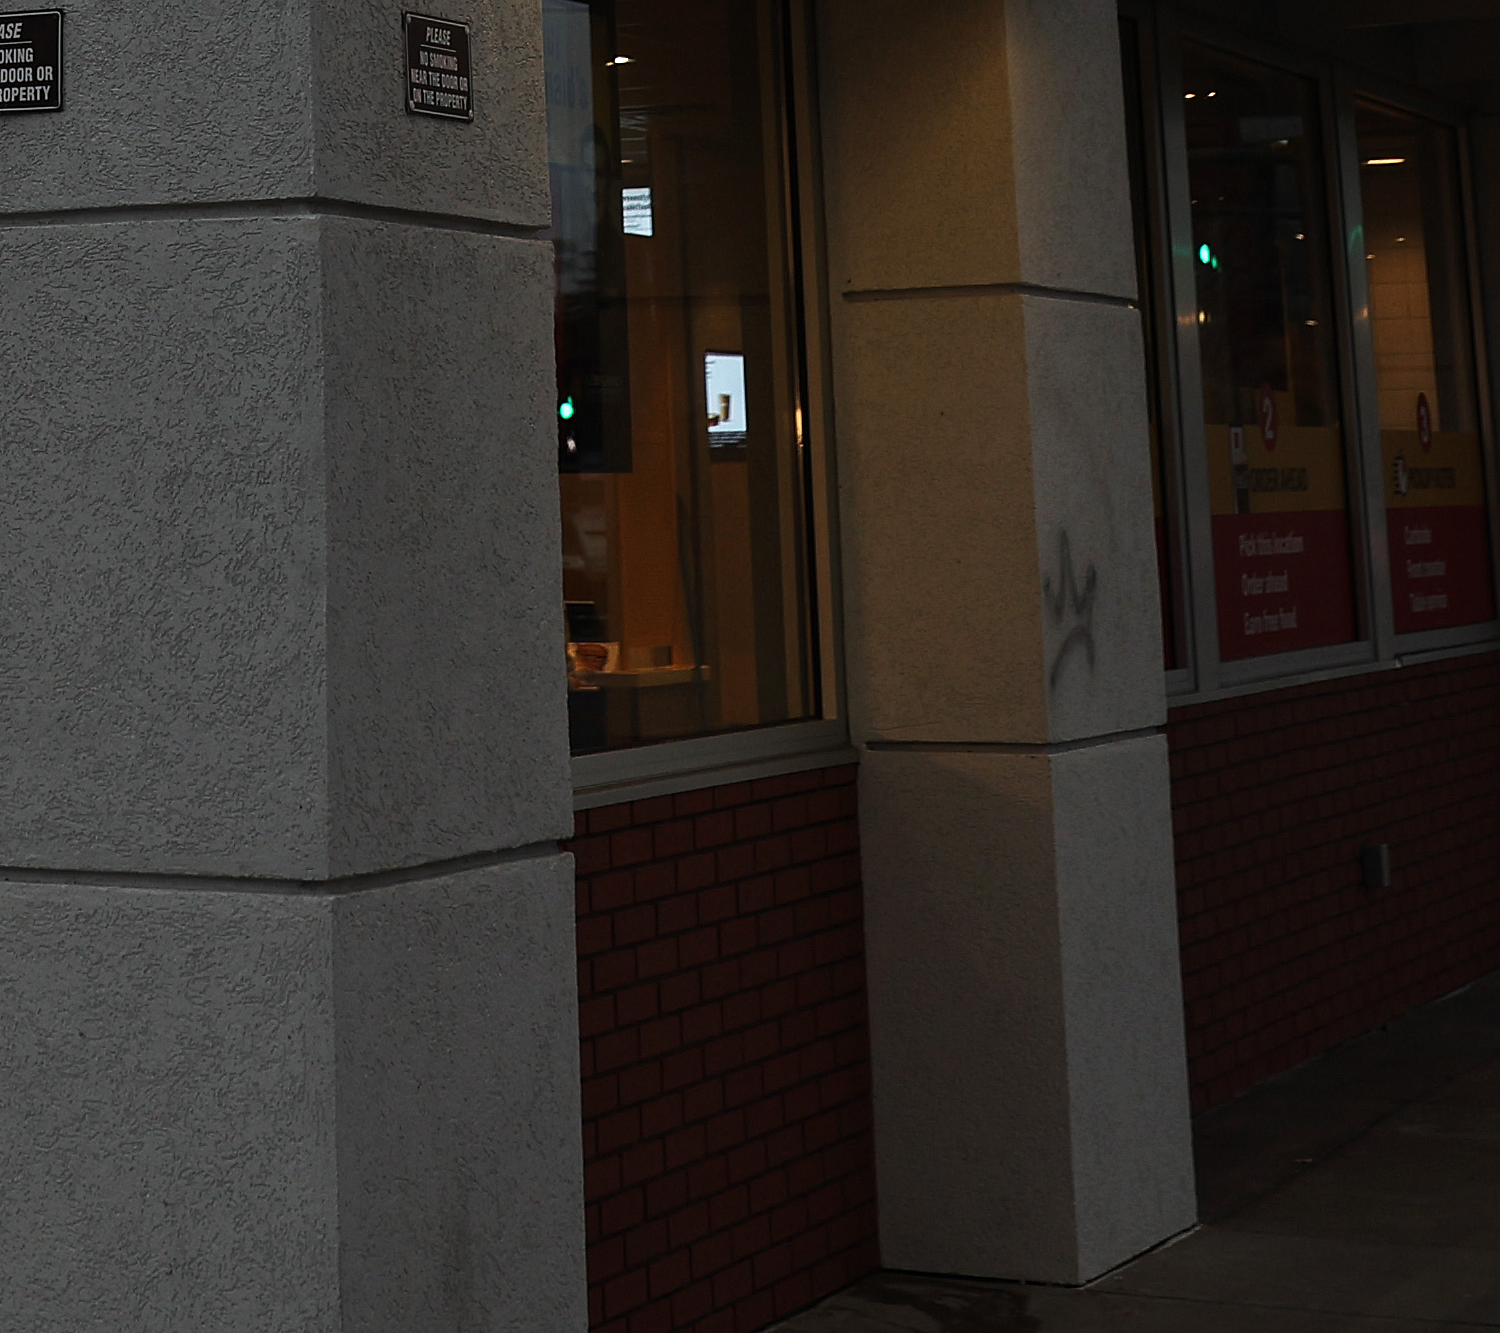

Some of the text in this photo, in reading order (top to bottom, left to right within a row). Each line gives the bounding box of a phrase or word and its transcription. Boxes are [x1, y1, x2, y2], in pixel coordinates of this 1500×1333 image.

[426, 26, 451, 46] PLEASE
[430, 52, 458, 71] SMOKING
[0, 67, 33, 83] DOOR
[36, 66, 53, 82] OR
[429, 71, 440, 87] THE
[423, 89, 435, 105] THE
[436, 91, 468, 110] PROPERTY
